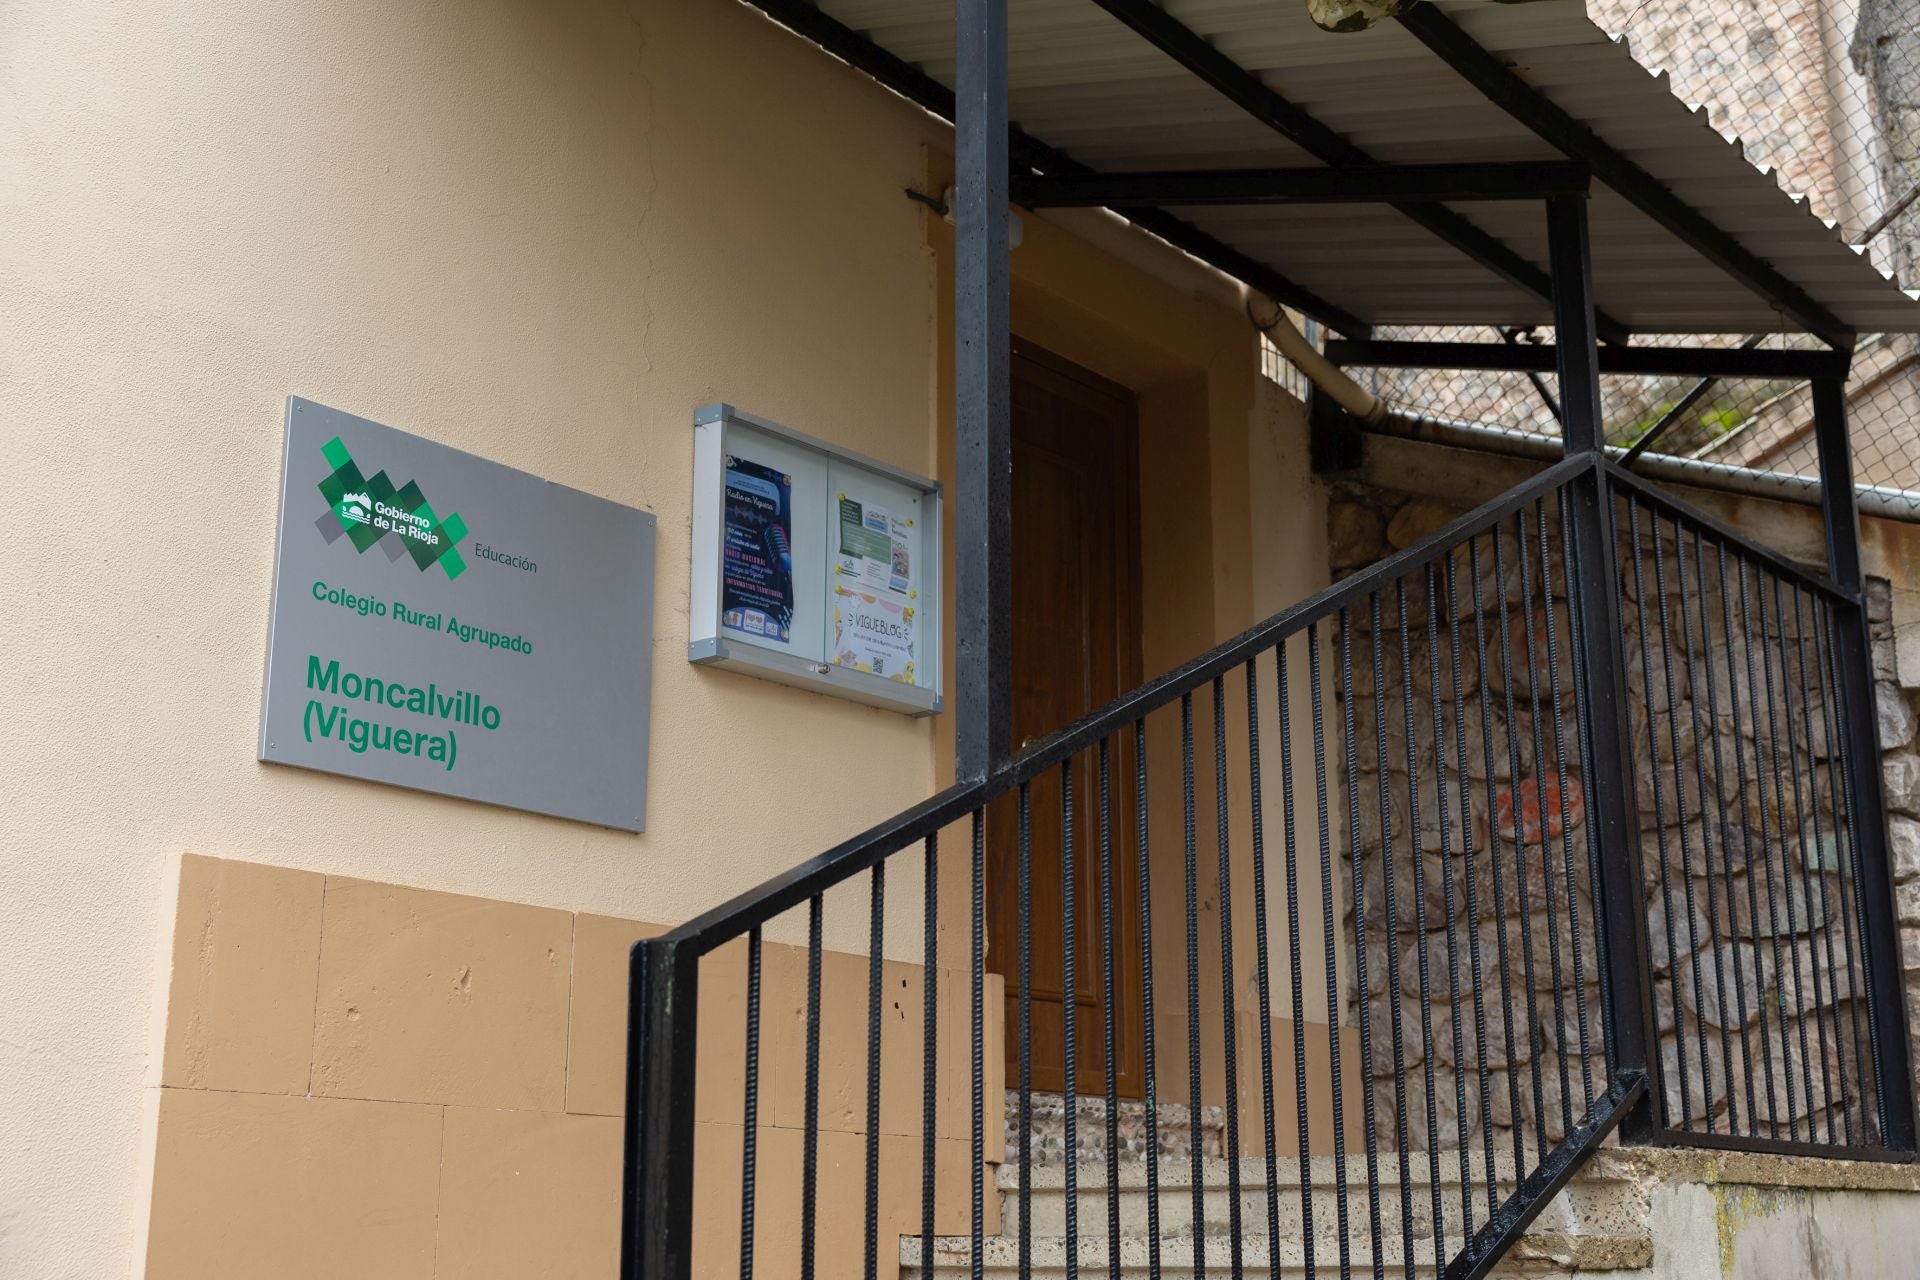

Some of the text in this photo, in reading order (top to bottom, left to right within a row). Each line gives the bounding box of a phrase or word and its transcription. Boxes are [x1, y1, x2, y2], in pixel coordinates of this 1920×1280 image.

[726, 488, 744, 501] Radio
[752, 495, 774, 511] Viguera
[374, 502, 430, 528] Gobierno
[373, 517, 439, 545] de La Rioja
[475, 543, 537, 573] Educación
[312, 581, 532, 654] Colegio Rural Agrupado
[855, 612, 902, 639] VIGUEBLOG
[307, 655, 500, 730] Moncalvillo
[303, 700, 457, 771] (Viguera)
